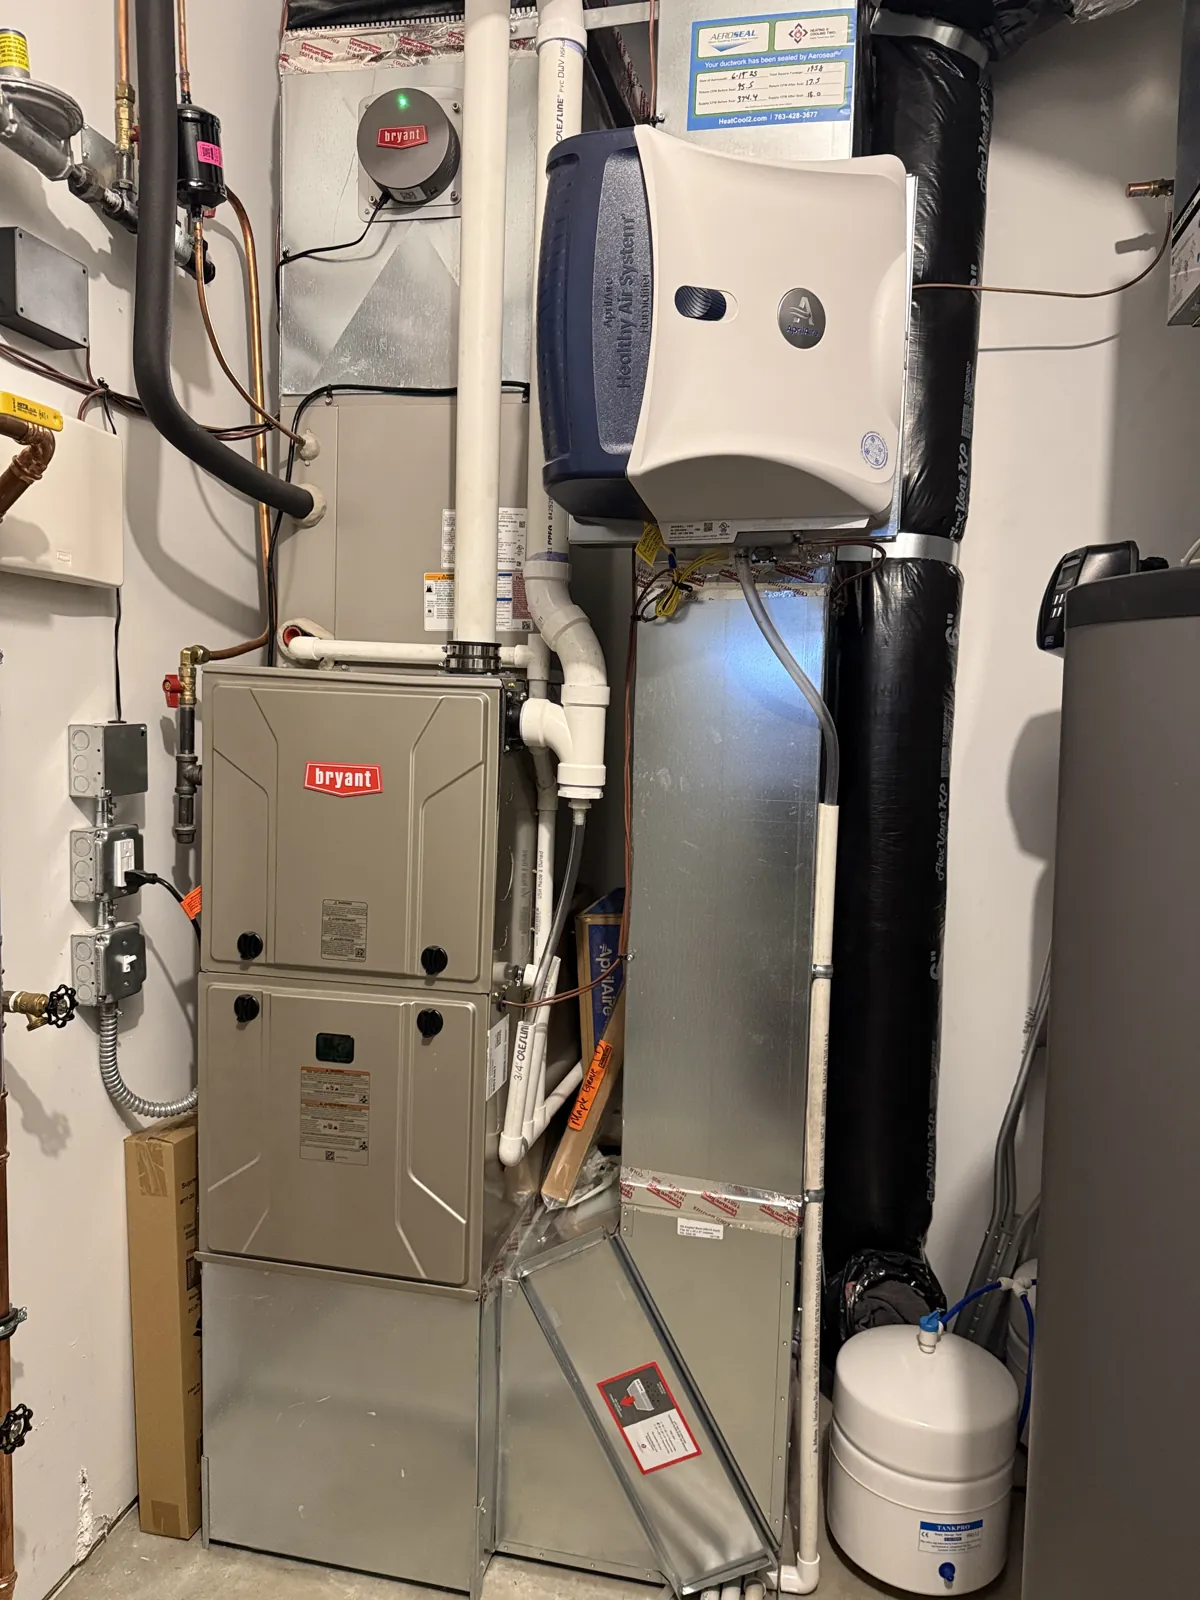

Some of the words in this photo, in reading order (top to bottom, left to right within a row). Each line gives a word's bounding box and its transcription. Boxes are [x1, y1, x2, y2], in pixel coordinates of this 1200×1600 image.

[710, 29, 757, 40] AEROSEAL
[720, 58, 747, 67] ductwork
[778, 54, 798, 62] sealed
[718, 116, 768, 124] HeatCool2.com
[384, 129, 420, 143] bryant
[603, 276, 616, 328] AprilAire
[618, 290, 633, 314] Air
[639, 273, 650, 334] Humidifier
[616, 312, 637, 389] Healthy
[958, 443, 968, 474] KP
[955, 474, 968, 514] Vent
[315, 767, 372, 788] bryant
[939, 783, 948, 804] KP
[936, 803, 947, 848] Vent
[596, 944, 615, 1016] AprilAire
[571, 1097, 588, 1126] Maple
